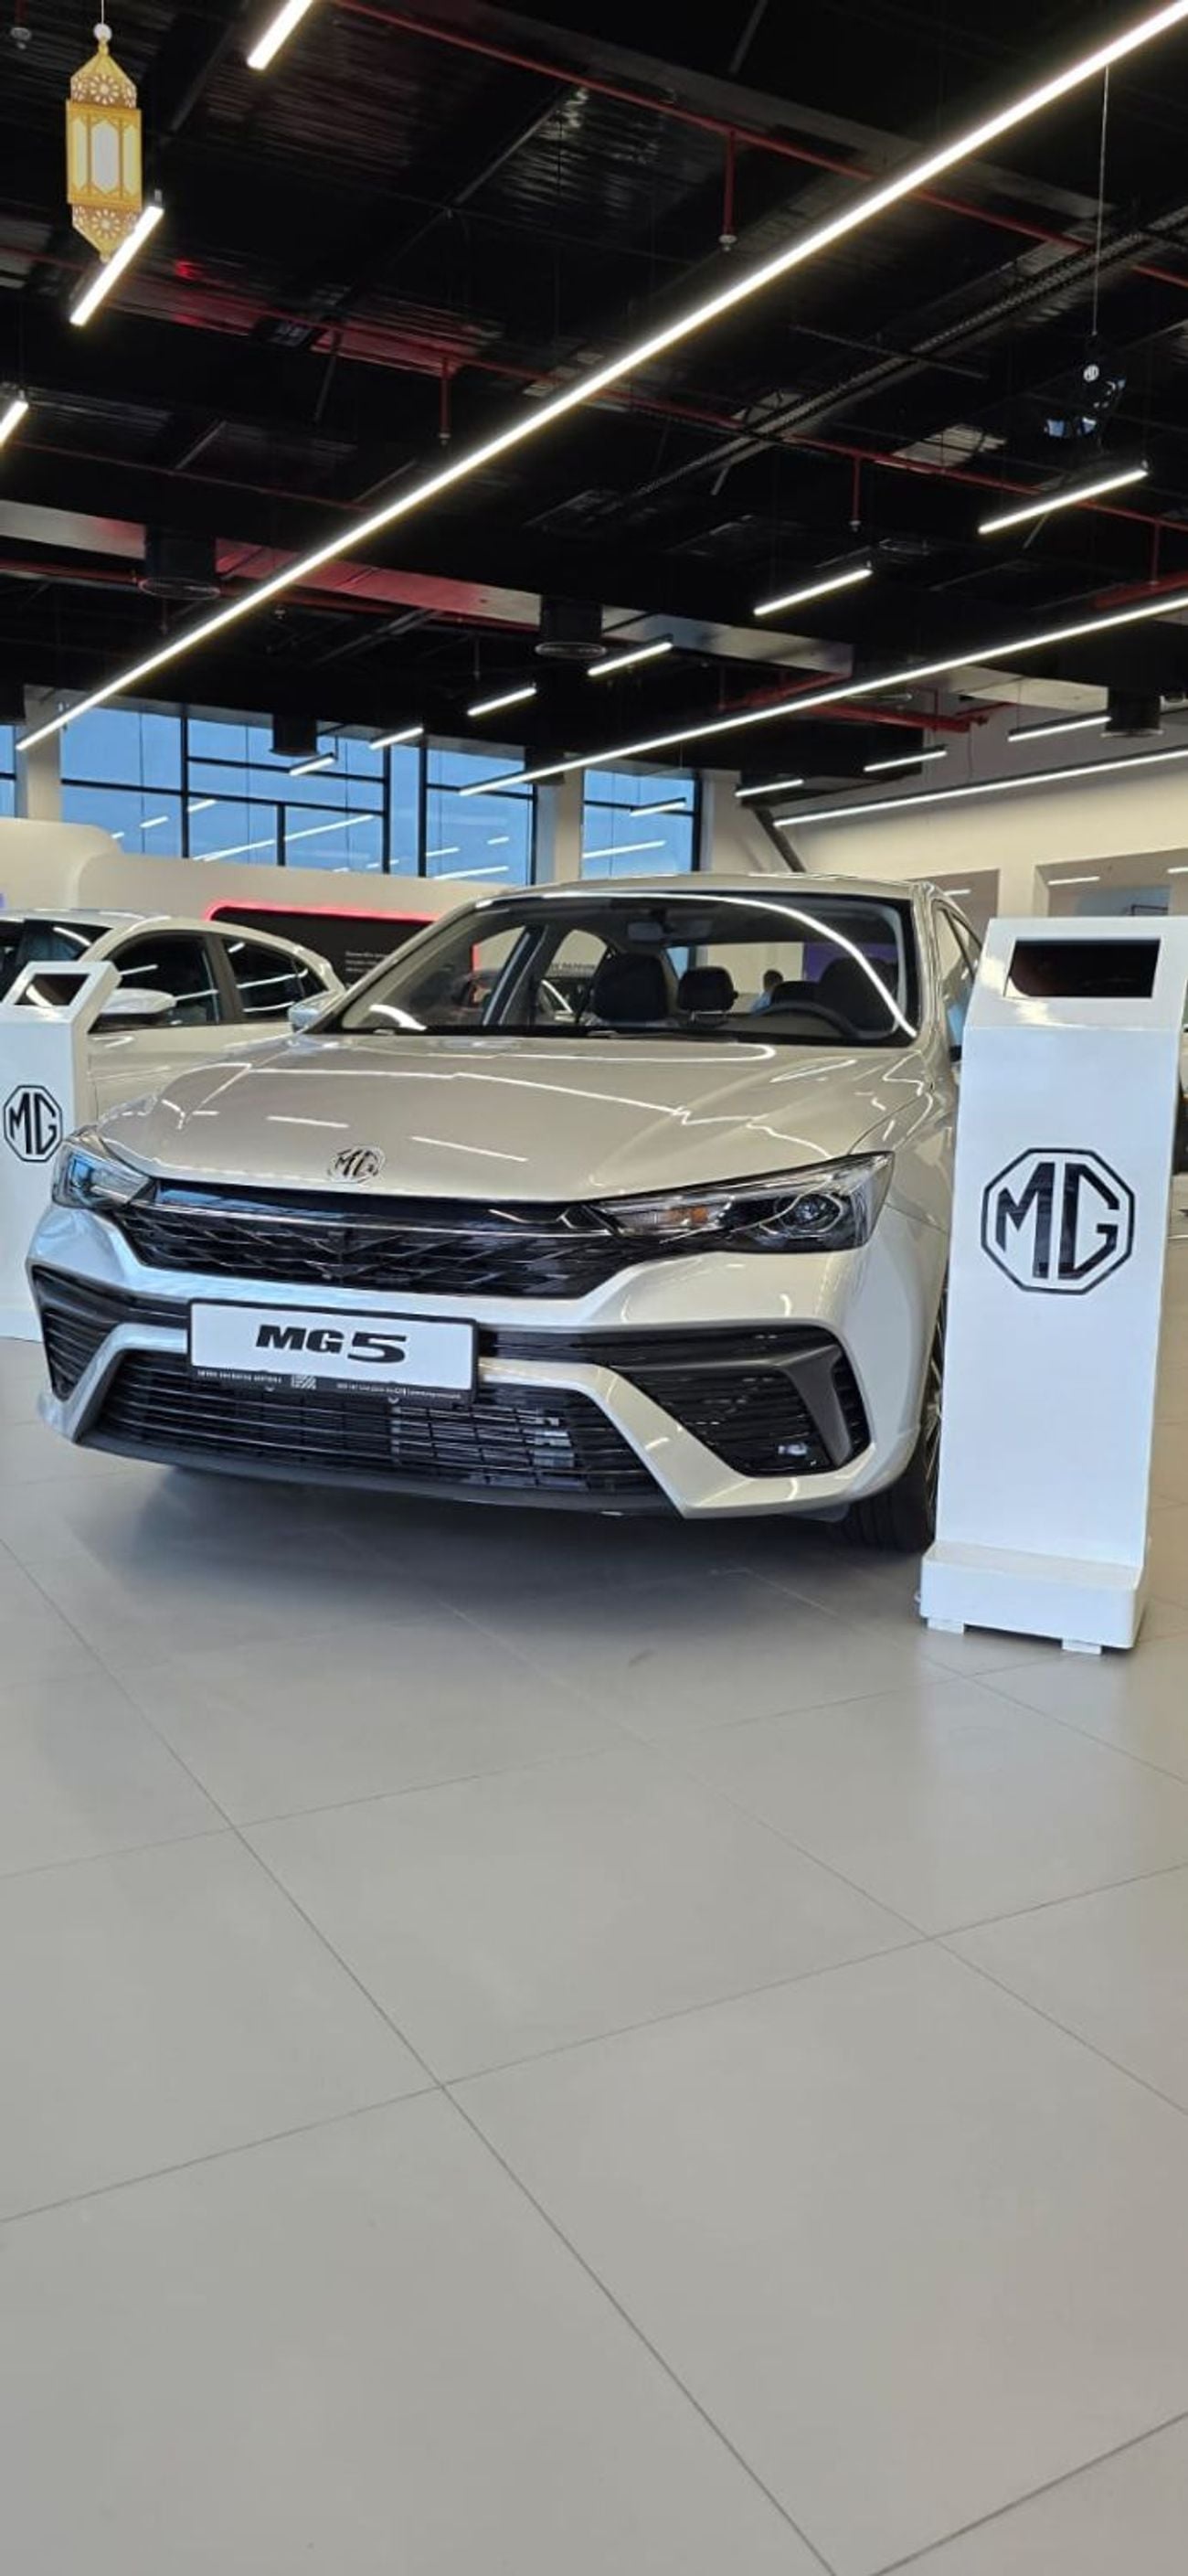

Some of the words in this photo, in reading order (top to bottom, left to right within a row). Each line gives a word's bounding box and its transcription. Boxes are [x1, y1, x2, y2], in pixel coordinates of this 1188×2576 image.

[8, 1091, 58, 1155] MG
[334, 1148, 380, 1178] MG
[995, 1161, 1121, 1280] MG
